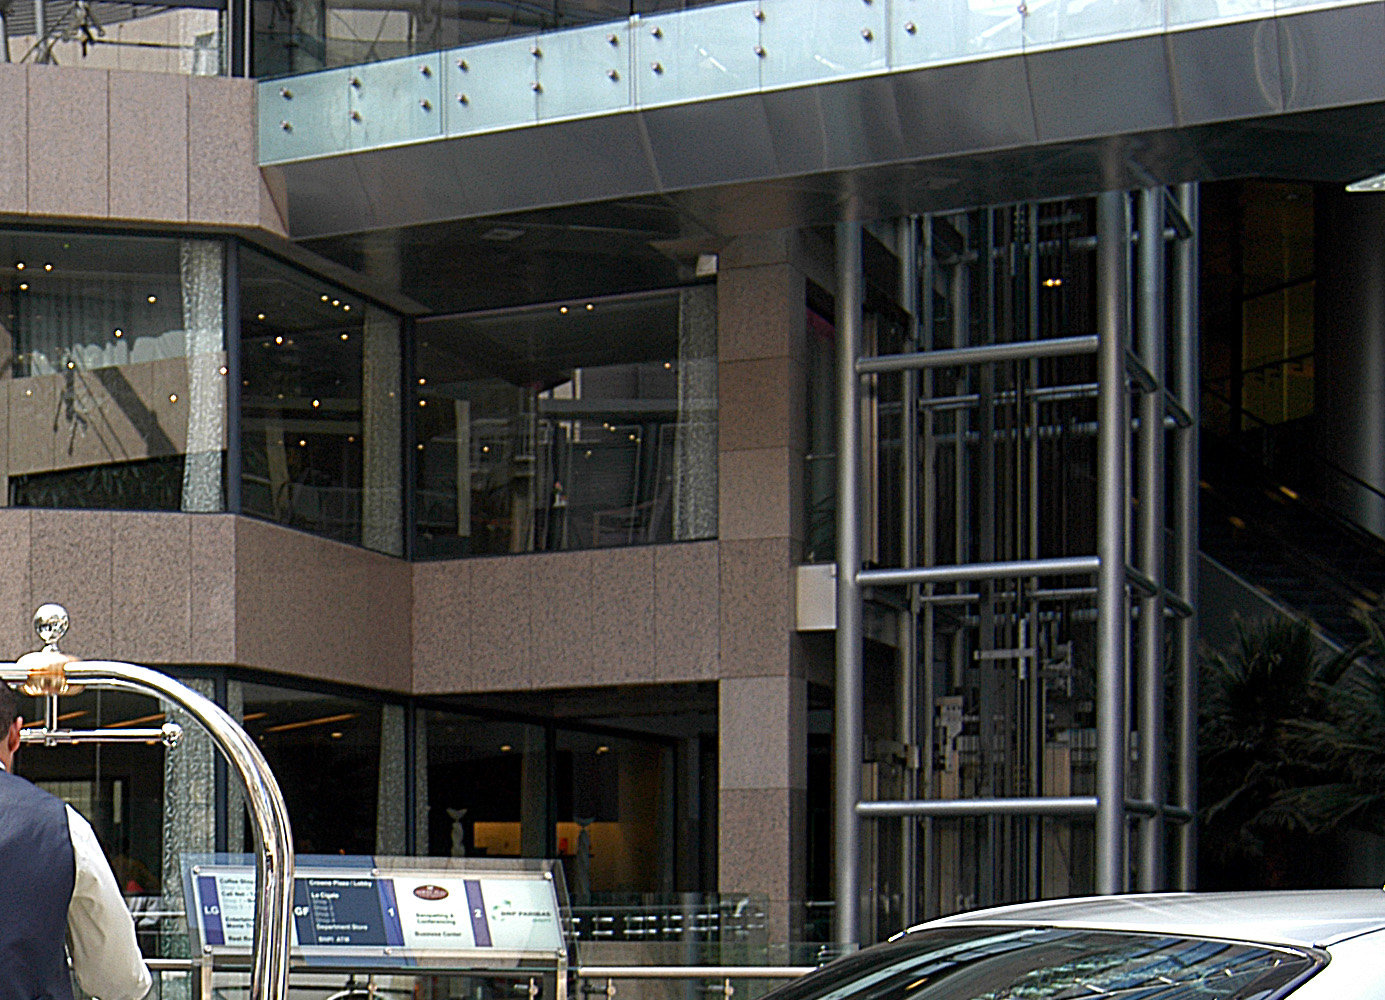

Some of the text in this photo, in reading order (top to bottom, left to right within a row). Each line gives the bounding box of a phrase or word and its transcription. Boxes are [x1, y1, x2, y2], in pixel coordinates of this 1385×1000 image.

[203, 905, 220, 915] LG
[294, 906, 309, 916] GF
[388, 907, 395, 917] 1
[474, 908, 483, 918] 2
